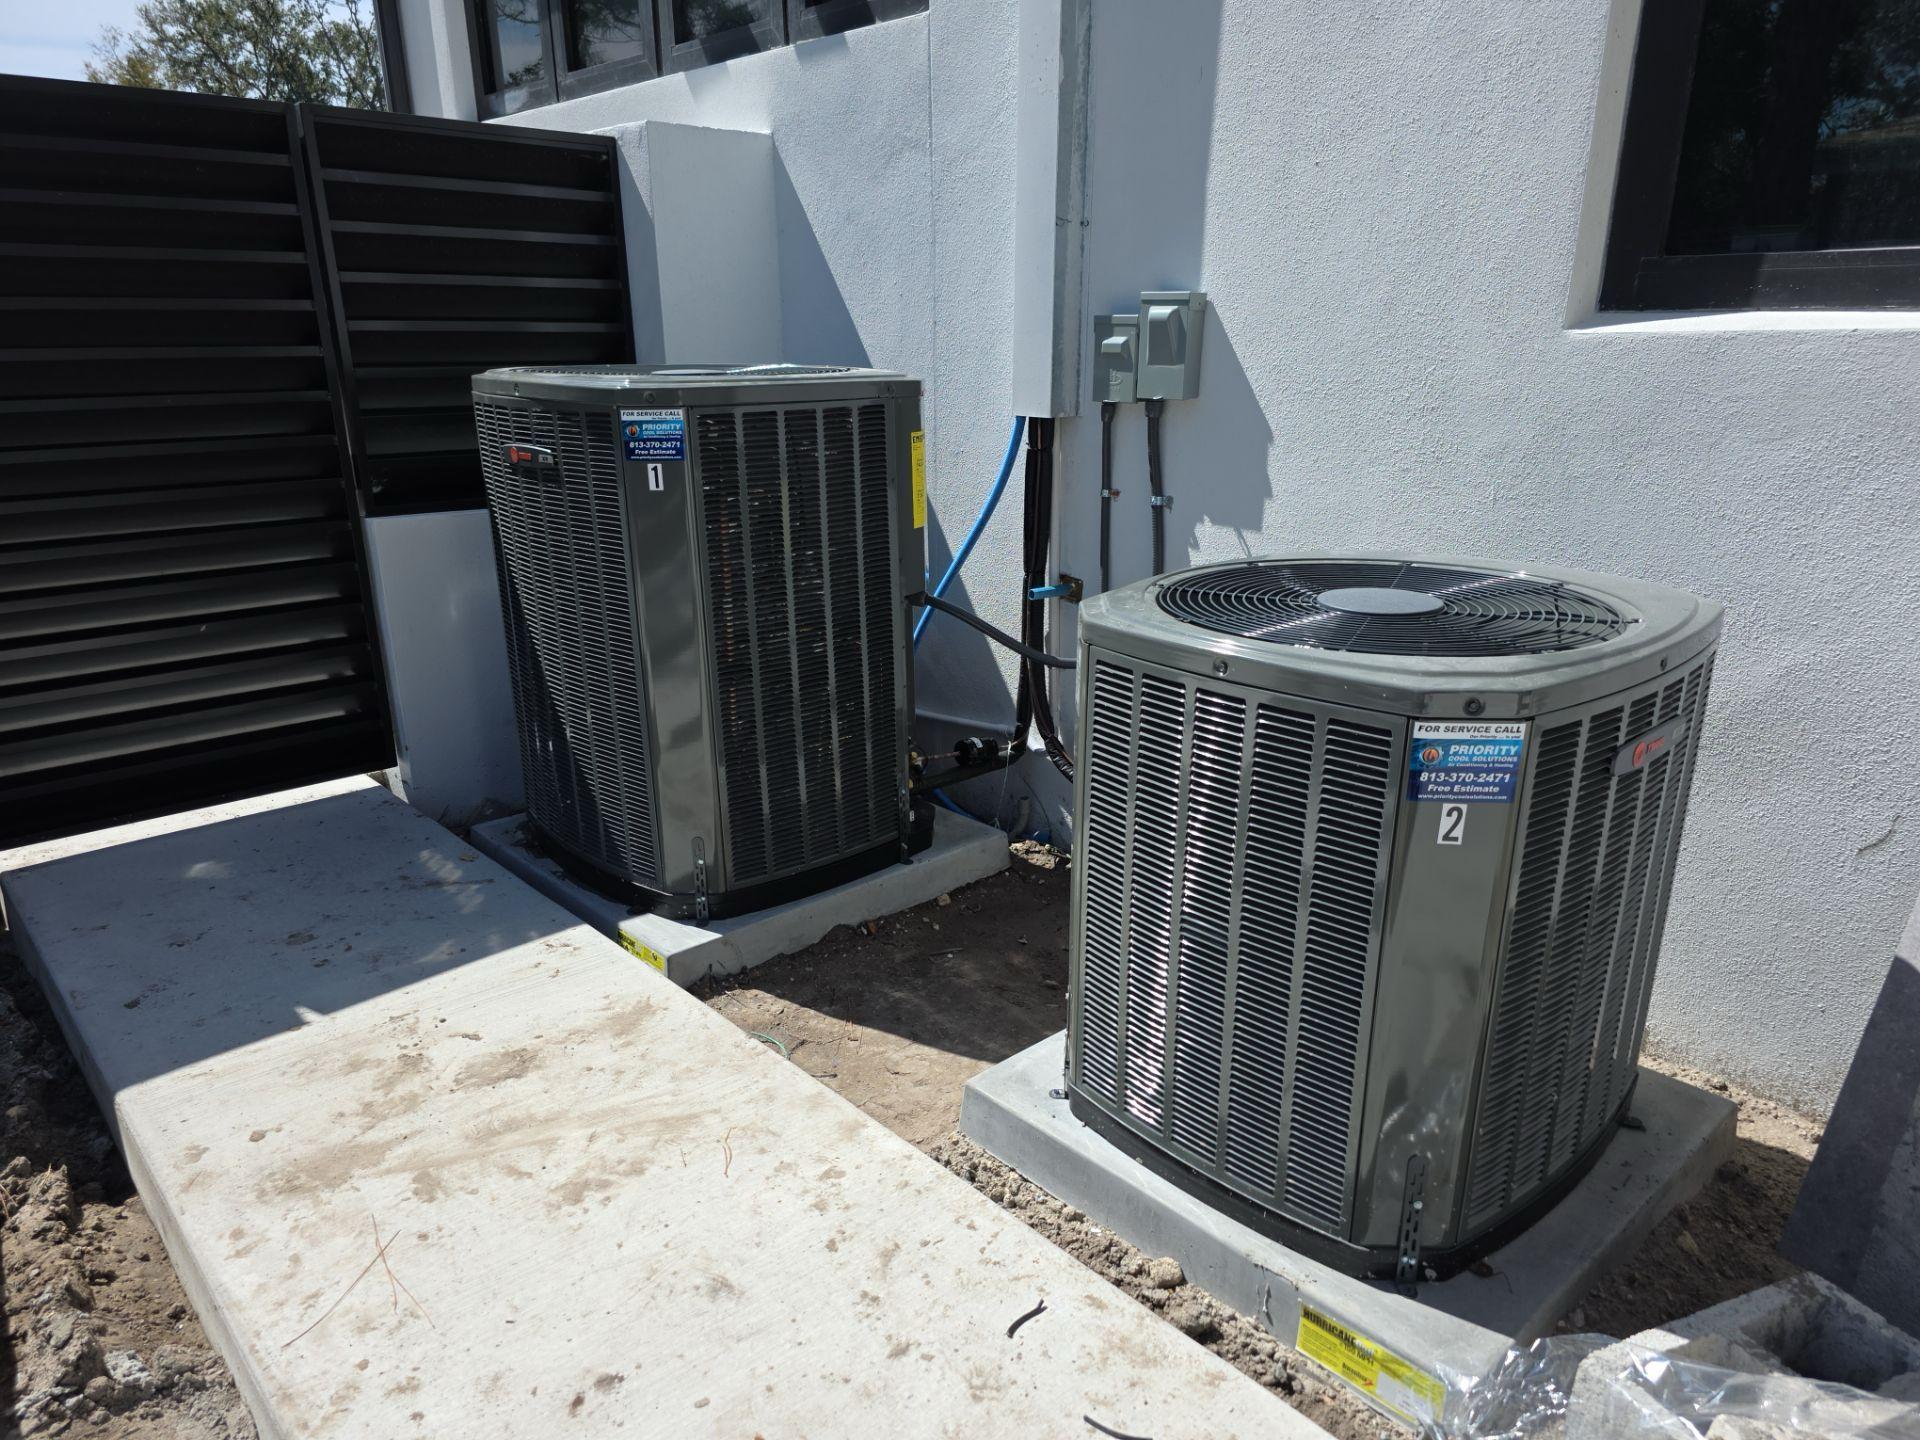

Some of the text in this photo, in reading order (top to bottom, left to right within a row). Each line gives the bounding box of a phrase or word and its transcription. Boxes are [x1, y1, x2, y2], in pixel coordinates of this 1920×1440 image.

[650, 465, 660, 489] 1
[1417, 725, 1522, 734] FOR SERVICE CALL
[1449, 745, 1519, 755] PRIORITY
[1420, 771, 1511, 783] 813-370-2471
[1427, 784, 1500, 794] Free Estimate
[1442, 806, 1464, 843] 2
